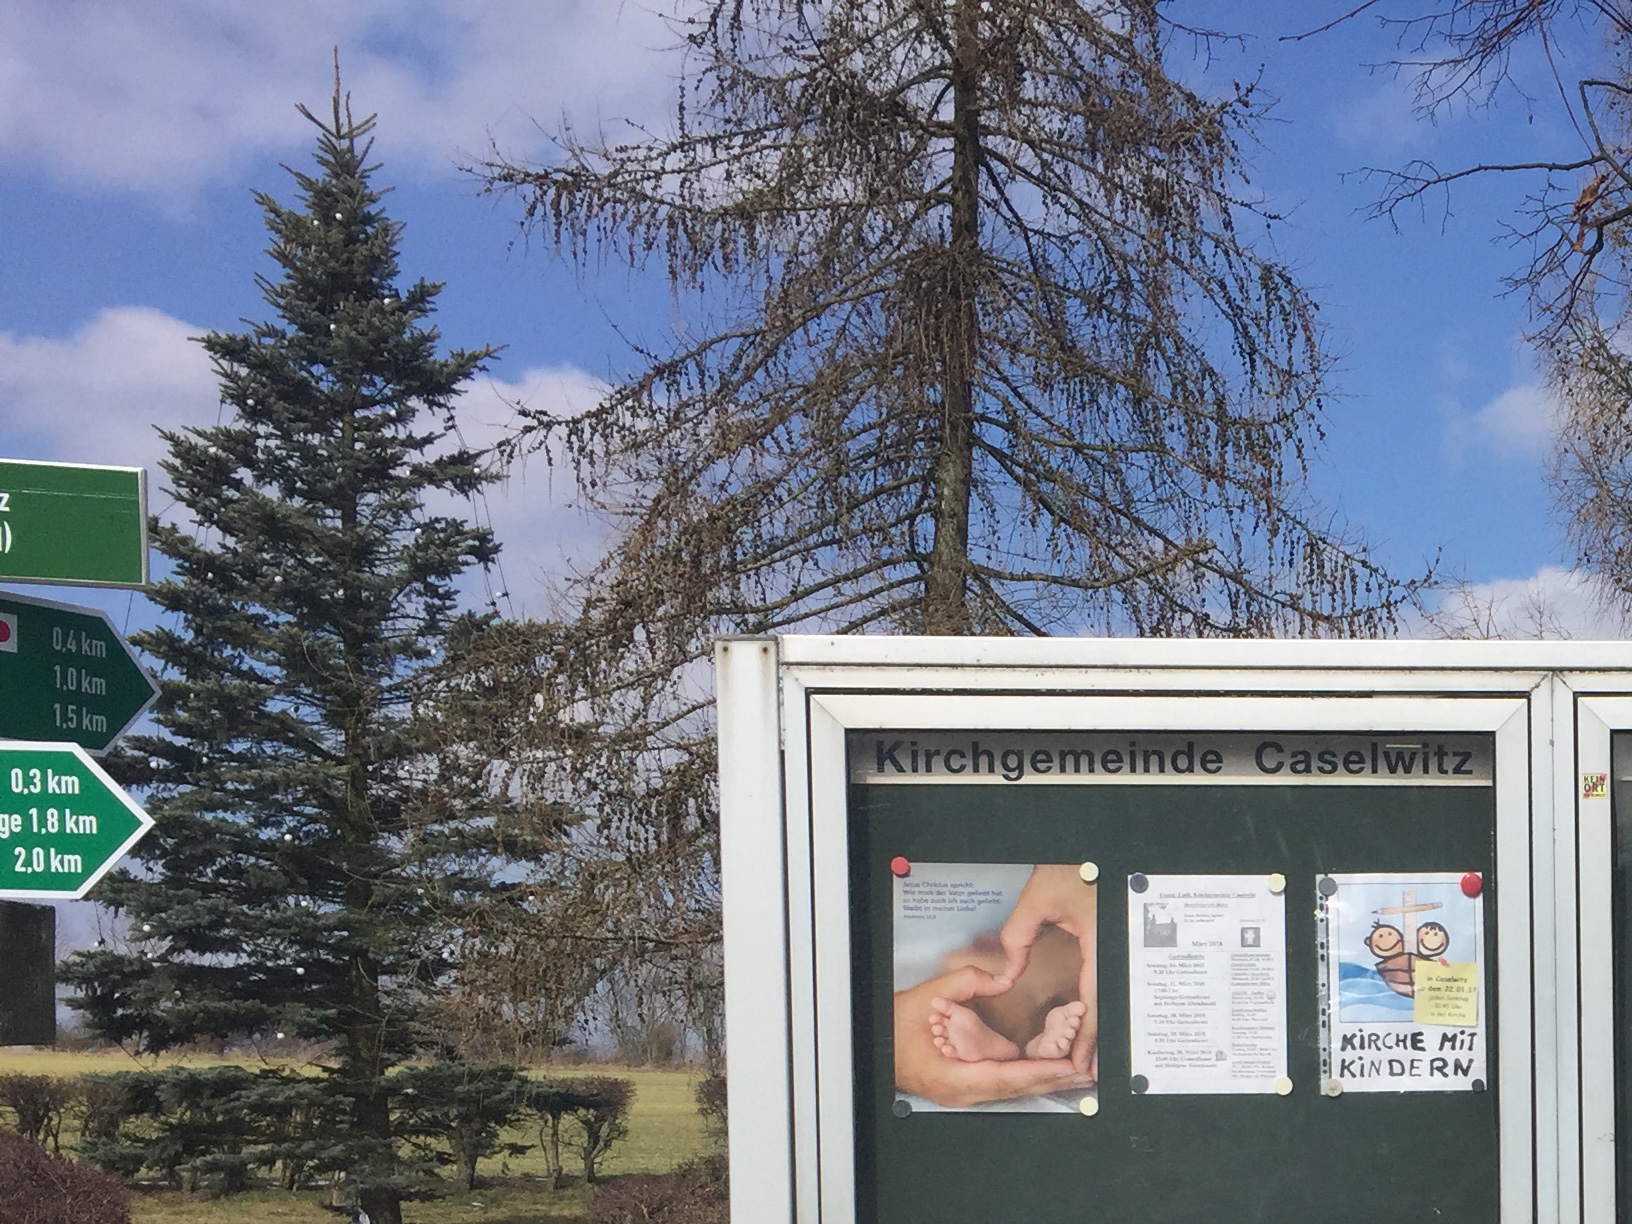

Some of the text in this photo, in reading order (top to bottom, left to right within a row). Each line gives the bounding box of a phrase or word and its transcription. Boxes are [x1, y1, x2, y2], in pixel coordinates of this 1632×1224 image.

[81, 630, 107, 659] km
[81, 668, 106, 696] km
[82, 706, 107, 733] km
[875, 738, 1475, 781] Kirchgemeinde Caselwitz
[10, 767, 80, 795] 0,3 km
[1583, 783, 1605, 793] ORT
[28, 807, 59, 835] 1,8
[64, 808, 98, 834] km
[14, 846, 83, 874] 2,0 km
